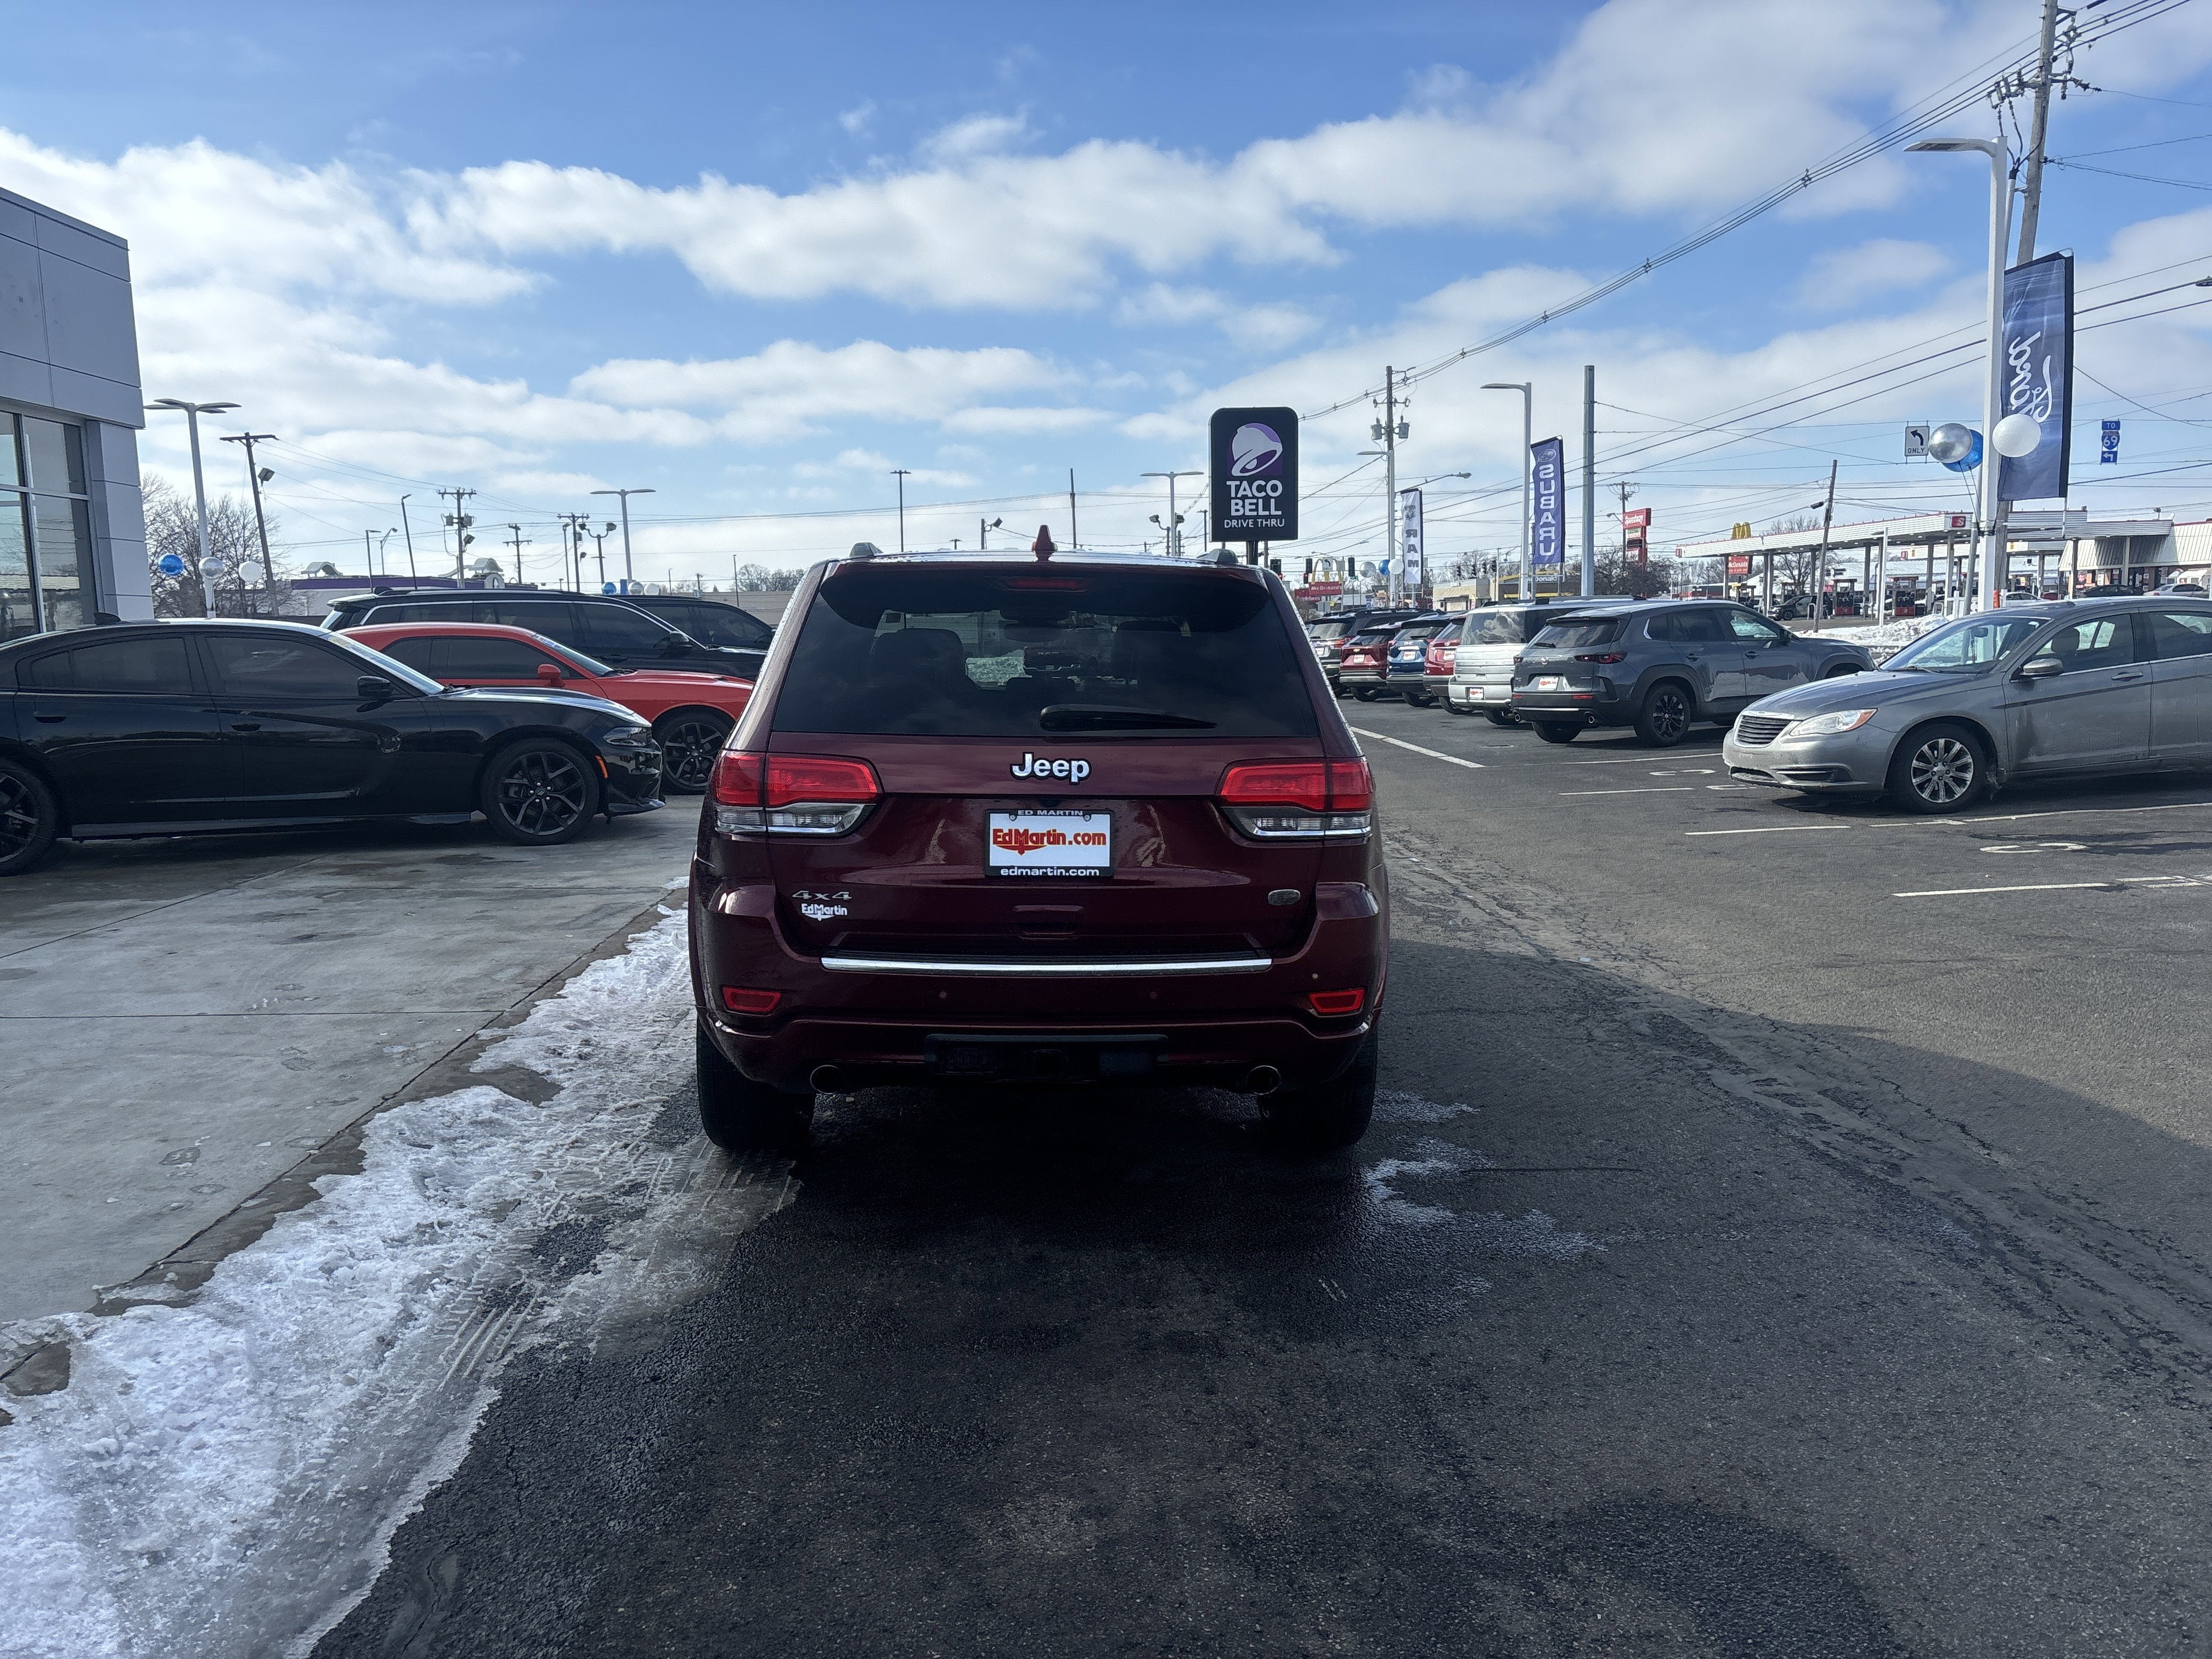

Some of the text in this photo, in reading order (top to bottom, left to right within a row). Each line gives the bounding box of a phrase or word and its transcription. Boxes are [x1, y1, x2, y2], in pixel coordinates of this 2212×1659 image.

[2103, 435, 2118, 447] 69
[1226, 479, 1283, 498] TACO
[1231, 498, 1282, 516] BELL
[1224, 518, 1285, 528] DRIVE THRU
[1012, 753, 1090, 782] Jeep
[992, 828, 1107, 847] EdMartin.com
[1000, 866, 1099, 876] edmartin.com
[792, 890, 853, 901] 4x4
[801, 903, 848, 916] EdMartin
